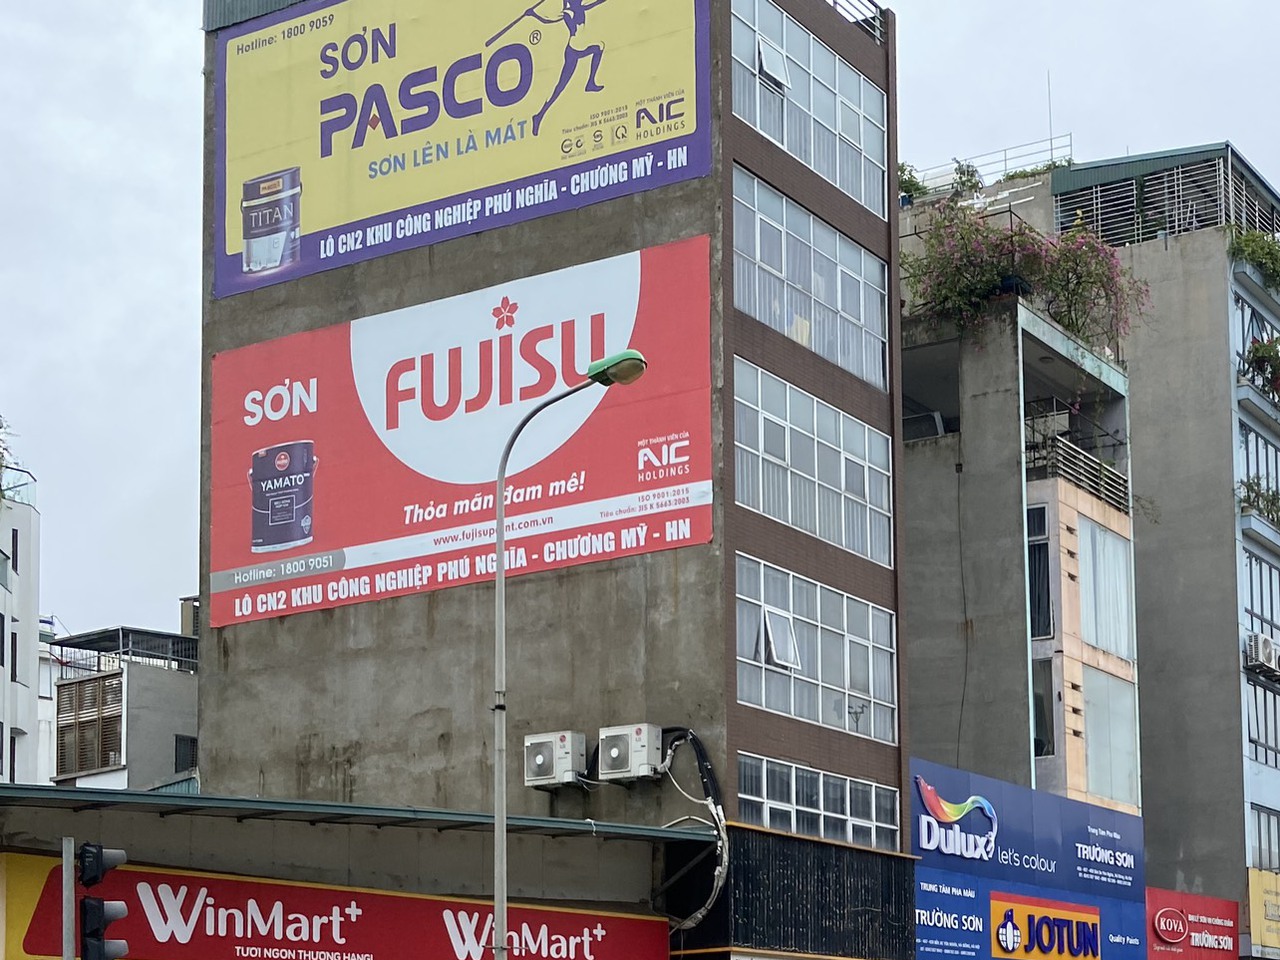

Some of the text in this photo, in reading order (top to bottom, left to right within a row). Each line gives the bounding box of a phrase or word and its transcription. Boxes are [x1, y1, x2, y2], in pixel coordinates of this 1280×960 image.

[236, 14, 334, 55] Hotline: 1800 9059
[320, 23, 396, 79] SƠN
[320, 43, 533, 158] PASCO
[636, 120, 686, 141] HOLDINGS
[368, 118, 527, 179] SƠN LÊN LÀ MÁT
[249, 202, 293, 228] TITAN
[320, 146, 688, 259] LÔ CN2 KHU CÔNG NGHIỆP PHÚ NGHĨA CHƯƠNG MỸ HN
[385, 312, 606, 431] FUJISU
[243, 377, 318, 426] SƠN
[261, 474, 304, 492] YAMATO
[638, 464, 690, 483] HOLDINGS
[403, 470, 586, 525] Thỏa mãn đam mê!
[433, 516, 553, 546] www.fujisupnt.com.vn
[234, 555, 333, 584] Hotline: 1800 9051
[235, 594, 251, 617] LÔ
[257, 591, 286, 613] CN2
[291, 584, 322, 607] KHU
[327, 577, 370, 601] CÔNG
[375, 564, 432, 593] NGHIỆP
[437, 555, 470, 582] PHÚ
[543, 531, 615, 562] CHƯƠNG
[621, 522, 648, 549] MỸ
[666, 518, 690, 542] HN
[918, 813, 989, 861] Dulux
[998, 846, 1056, 873] let's colour
[1075, 842, 1134, 869] TRƯỜNG SƠN
[920, 882, 976, 899] TRUNG TÂM PHA MÀU
[915, 907, 983, 932] TRƯỜNG SƠN
[1160, 917, 1184, 933] KOVA
[1024, 914, 1098, 958] JOTUN
[1109, 934, 1140, 946] Quality Paints
[263, 948, 295, 960] NGON
